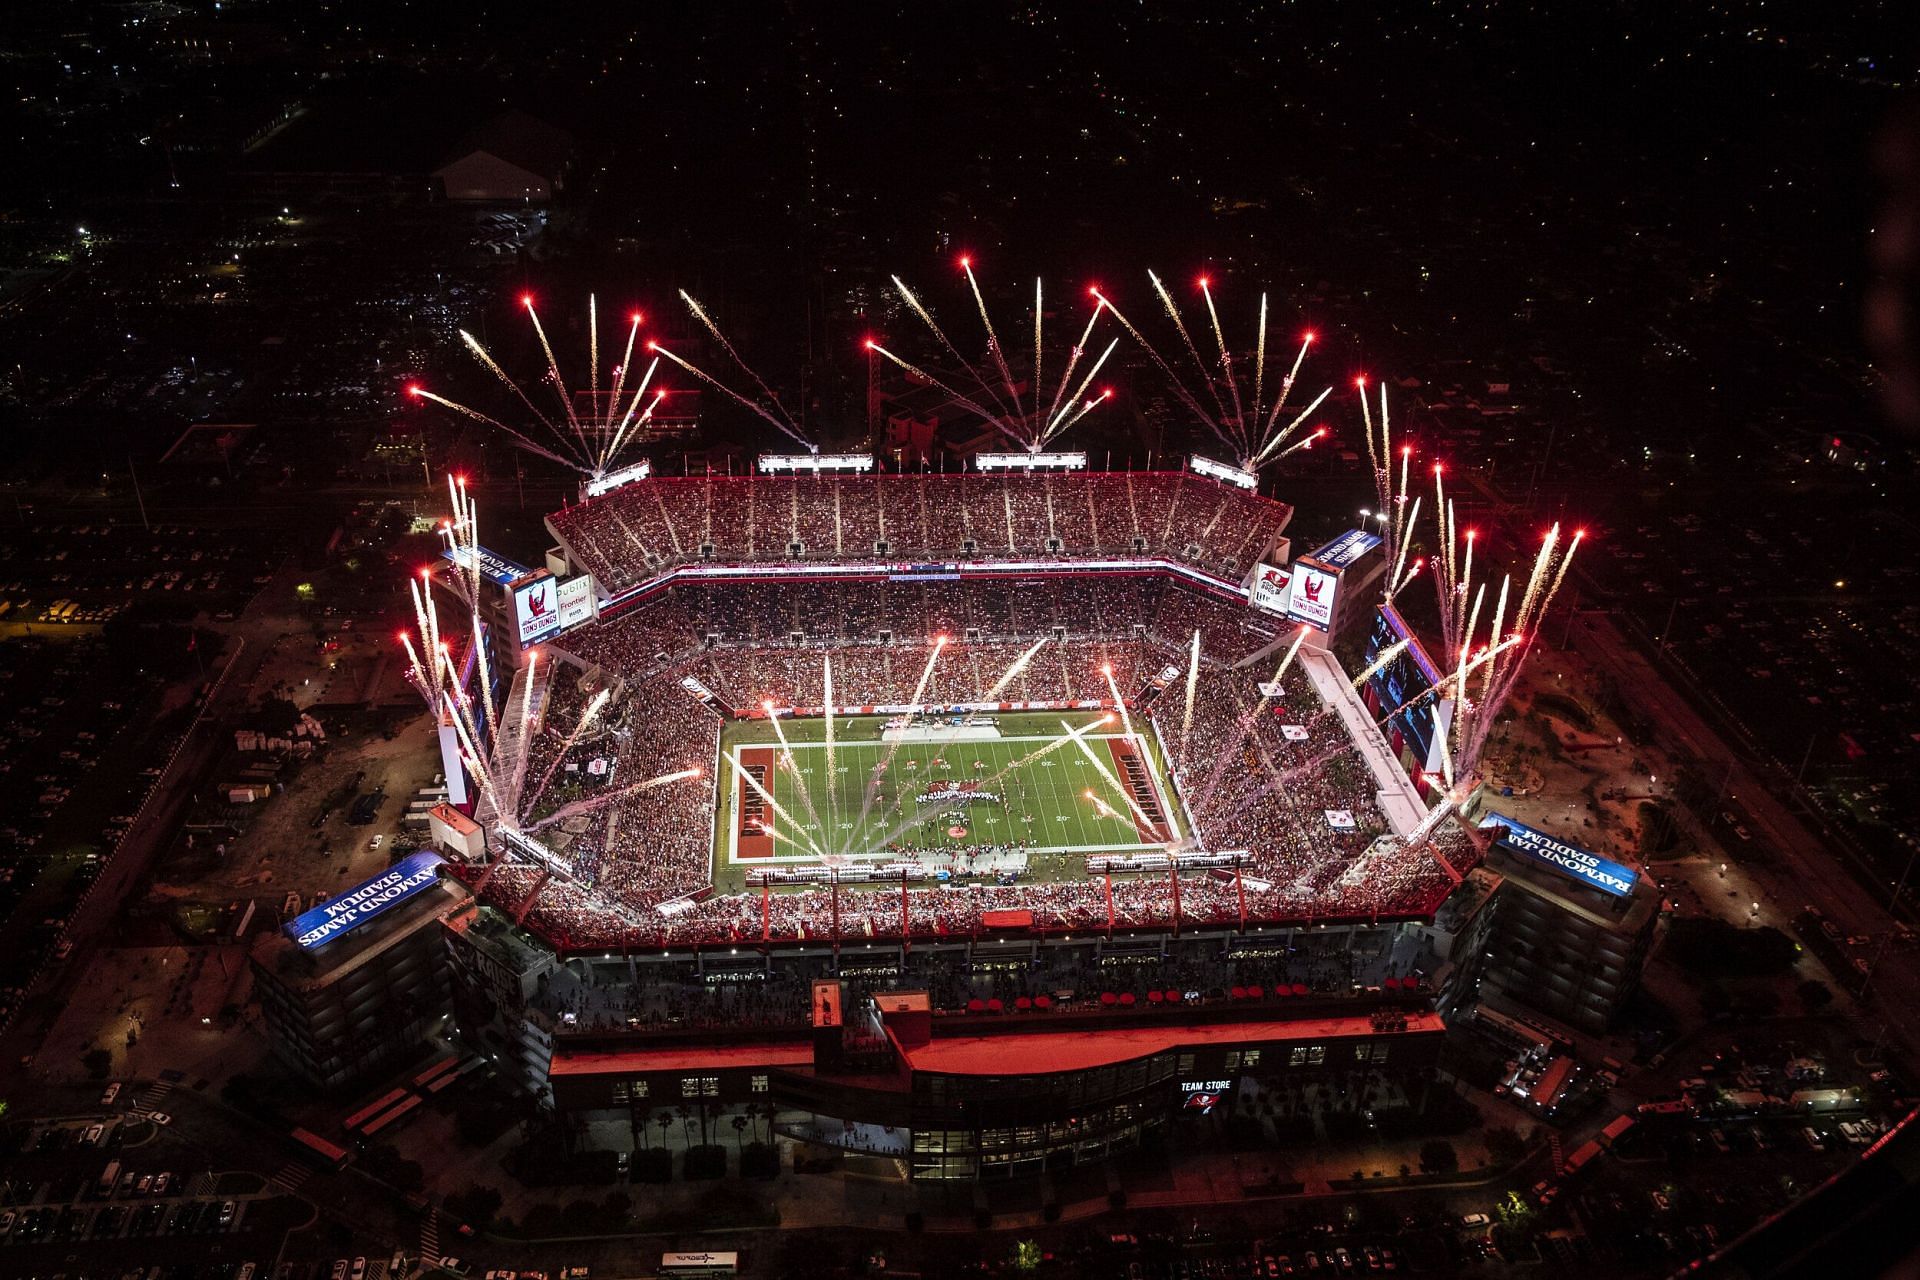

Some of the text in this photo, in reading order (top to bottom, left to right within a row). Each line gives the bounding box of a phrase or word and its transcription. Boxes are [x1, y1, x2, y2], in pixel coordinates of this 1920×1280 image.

[557, 580, 588, 597] Publix
[560, 594, 587, 610] Frontier
[1292, 599, 1307, 611] TONY
[1307, 604, 1328, 618] DUNGY
[522, 622, 538, 635] TONY
[538, 614, 557, 629] DUNGY
[1521, 829, 1600, 868] STADIUM
[1538, 848, 1632, 893] RAYMOND
[323, 870, 403, 918] STADIUM
[296, 908, 358, 947] JAMES
[1181, 1080, 1231, 1092] TEAM STORE
